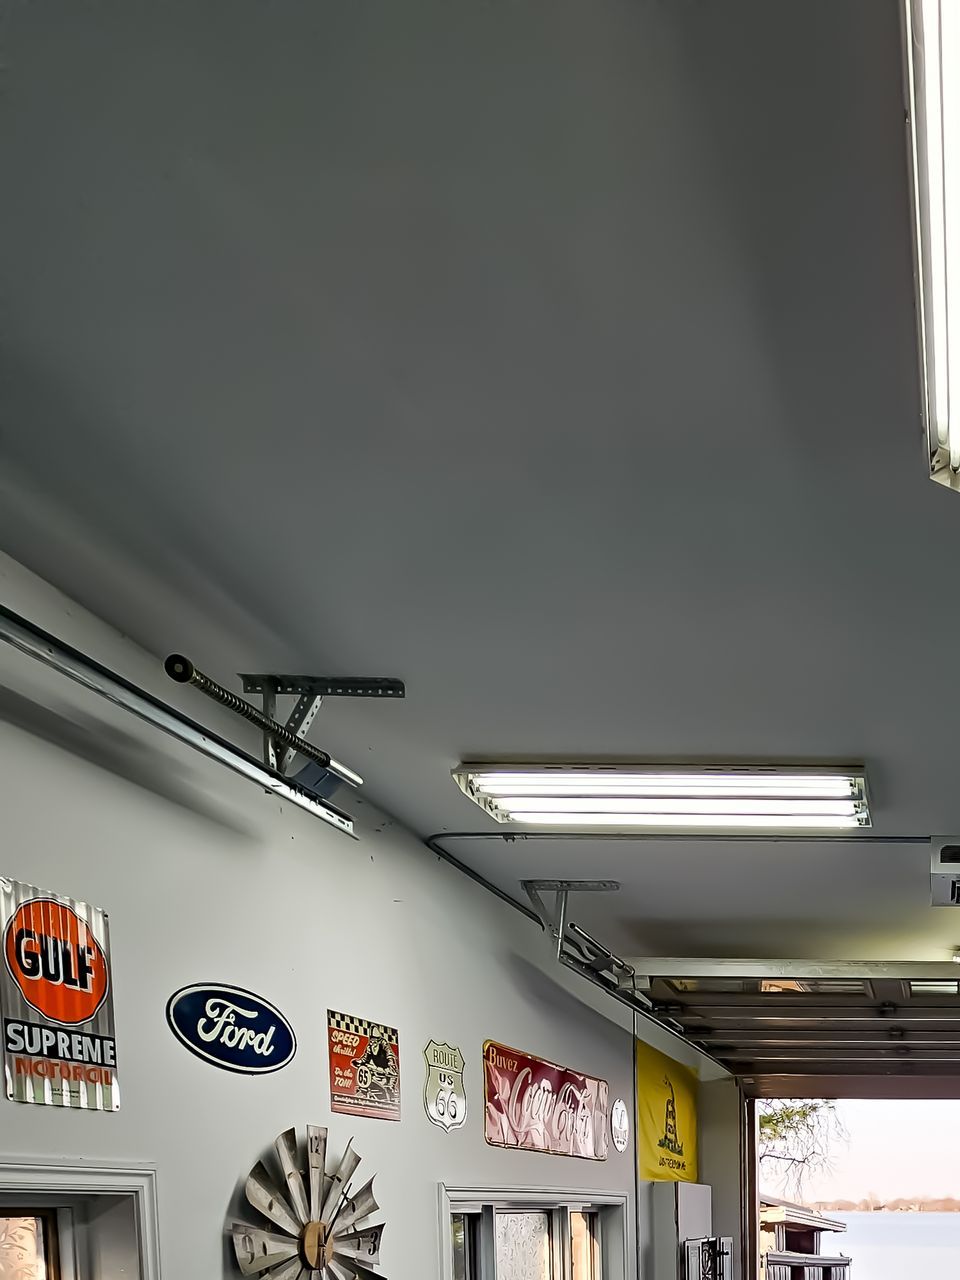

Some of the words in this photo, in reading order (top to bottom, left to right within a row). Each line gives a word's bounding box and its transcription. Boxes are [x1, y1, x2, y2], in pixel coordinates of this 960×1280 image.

[15, 928, 96, 993] GULF
[197, 998, 276, 1056] Ford
[331, 1030, 360, 1047] SPEED
[6, 1023, 115, 1066] SUPREME
[15, 1056, 83, 1082] MOTOR
[86, 1066, 113, 1086] OIL
[433, 1049, 458, 1069] ROUTE
[489, 1046, 518, 1073] Buvez
[358, 1068, 369, 1086] 65
[439, 1073, 454, 1086] US
[436, 1089, 458, 1119] 66
